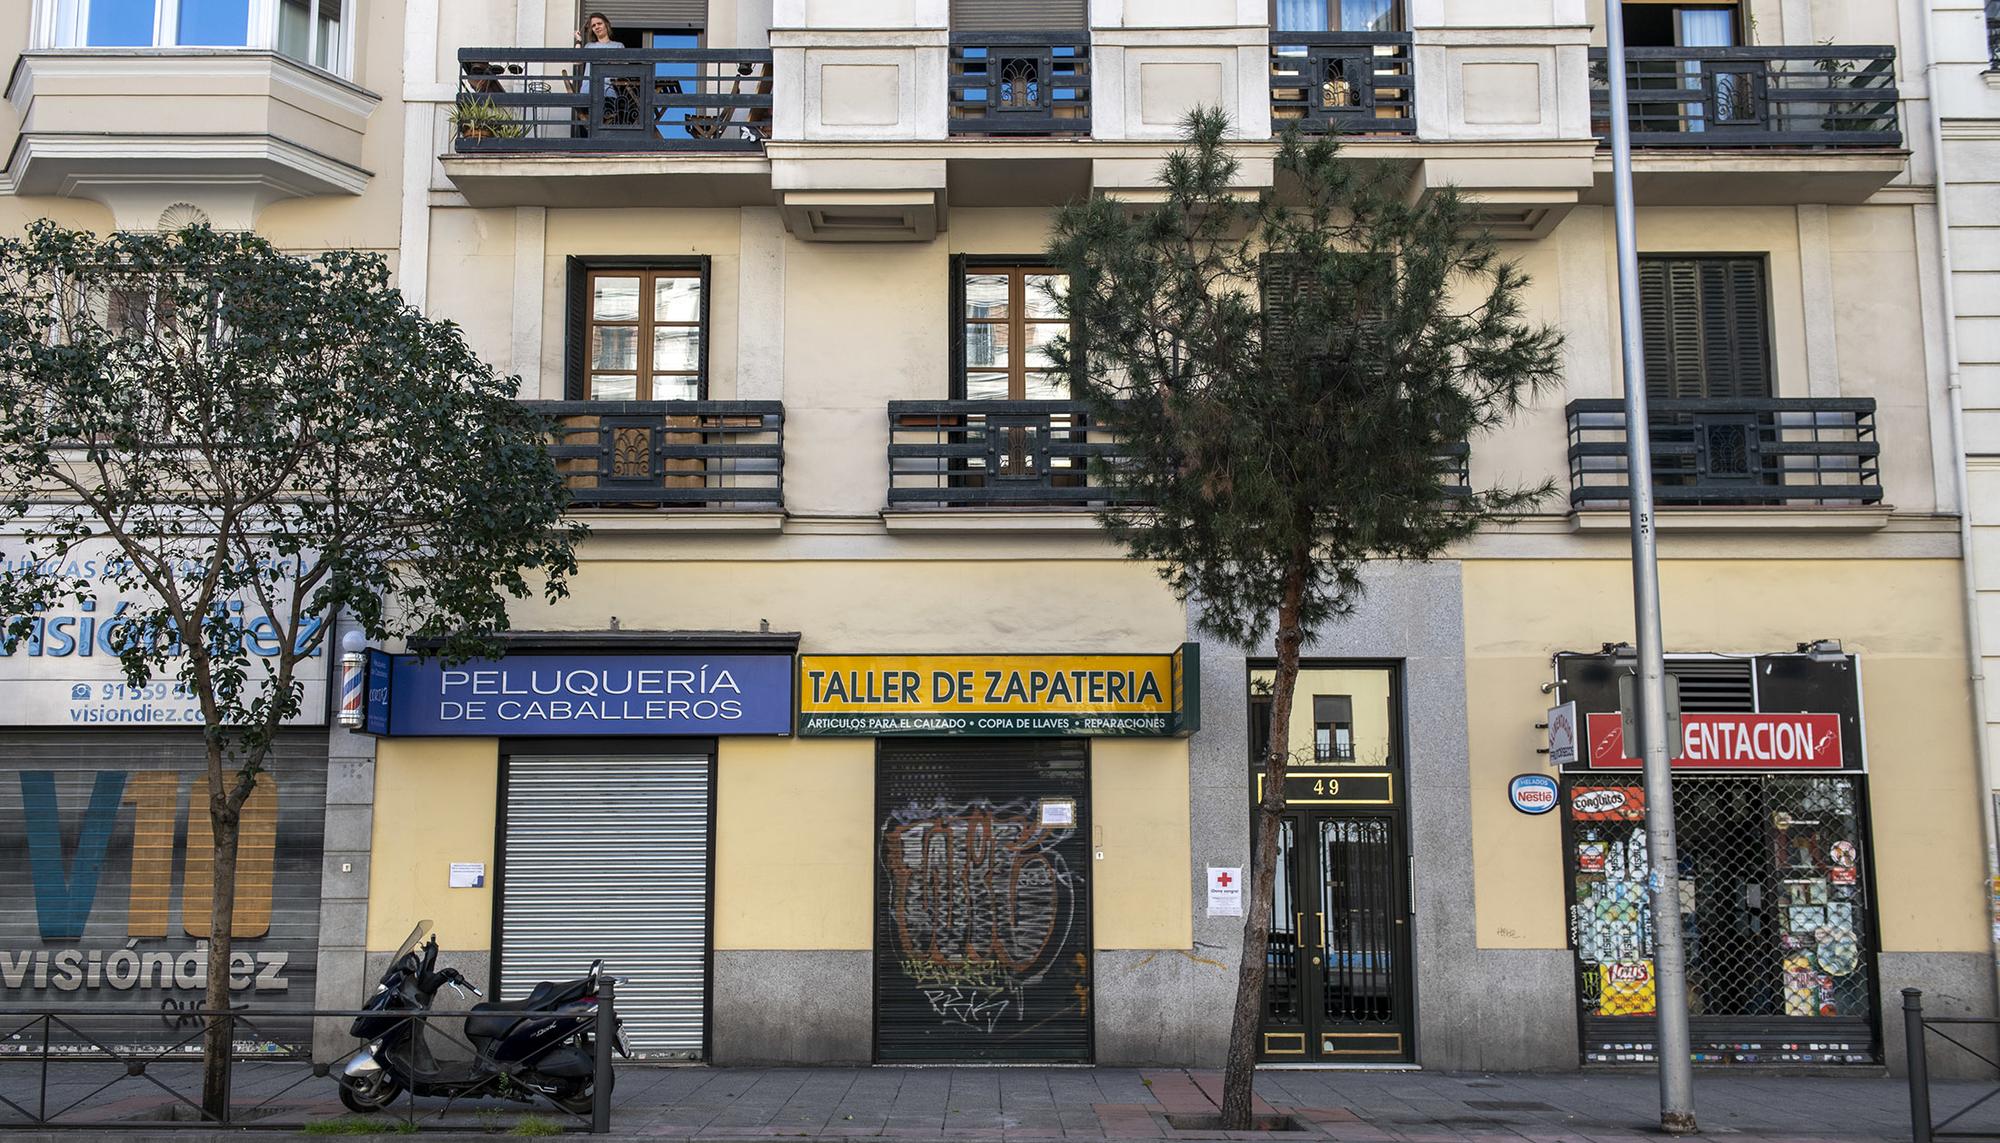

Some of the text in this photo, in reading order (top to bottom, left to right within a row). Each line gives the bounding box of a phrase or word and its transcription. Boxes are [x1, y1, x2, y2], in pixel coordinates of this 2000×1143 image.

[440, 664, 742, 697] PELUQUERÍA
[808, 670, 922, 704] TALLER
[932, 670, 975, 703] DE
[984, 670, 1164, 704] ZAPATERIA
[70, 704, 229, 722] visiondiez.co
[440, 700, 743, 720] DE CABALLEROS
[807, 718, 1166, 730] ARTICULOS PARA EL CALZADO COPIA DE LLAVES REPARACIONES
[1621, 722, 1815, 760] ENTACION
[1313, 779, 1340, 796] 49
[1519, 778, 1549, 786] HELADOS
[19, 769, 280, 939] V10
[0, 937, 289, 990] visióndez
